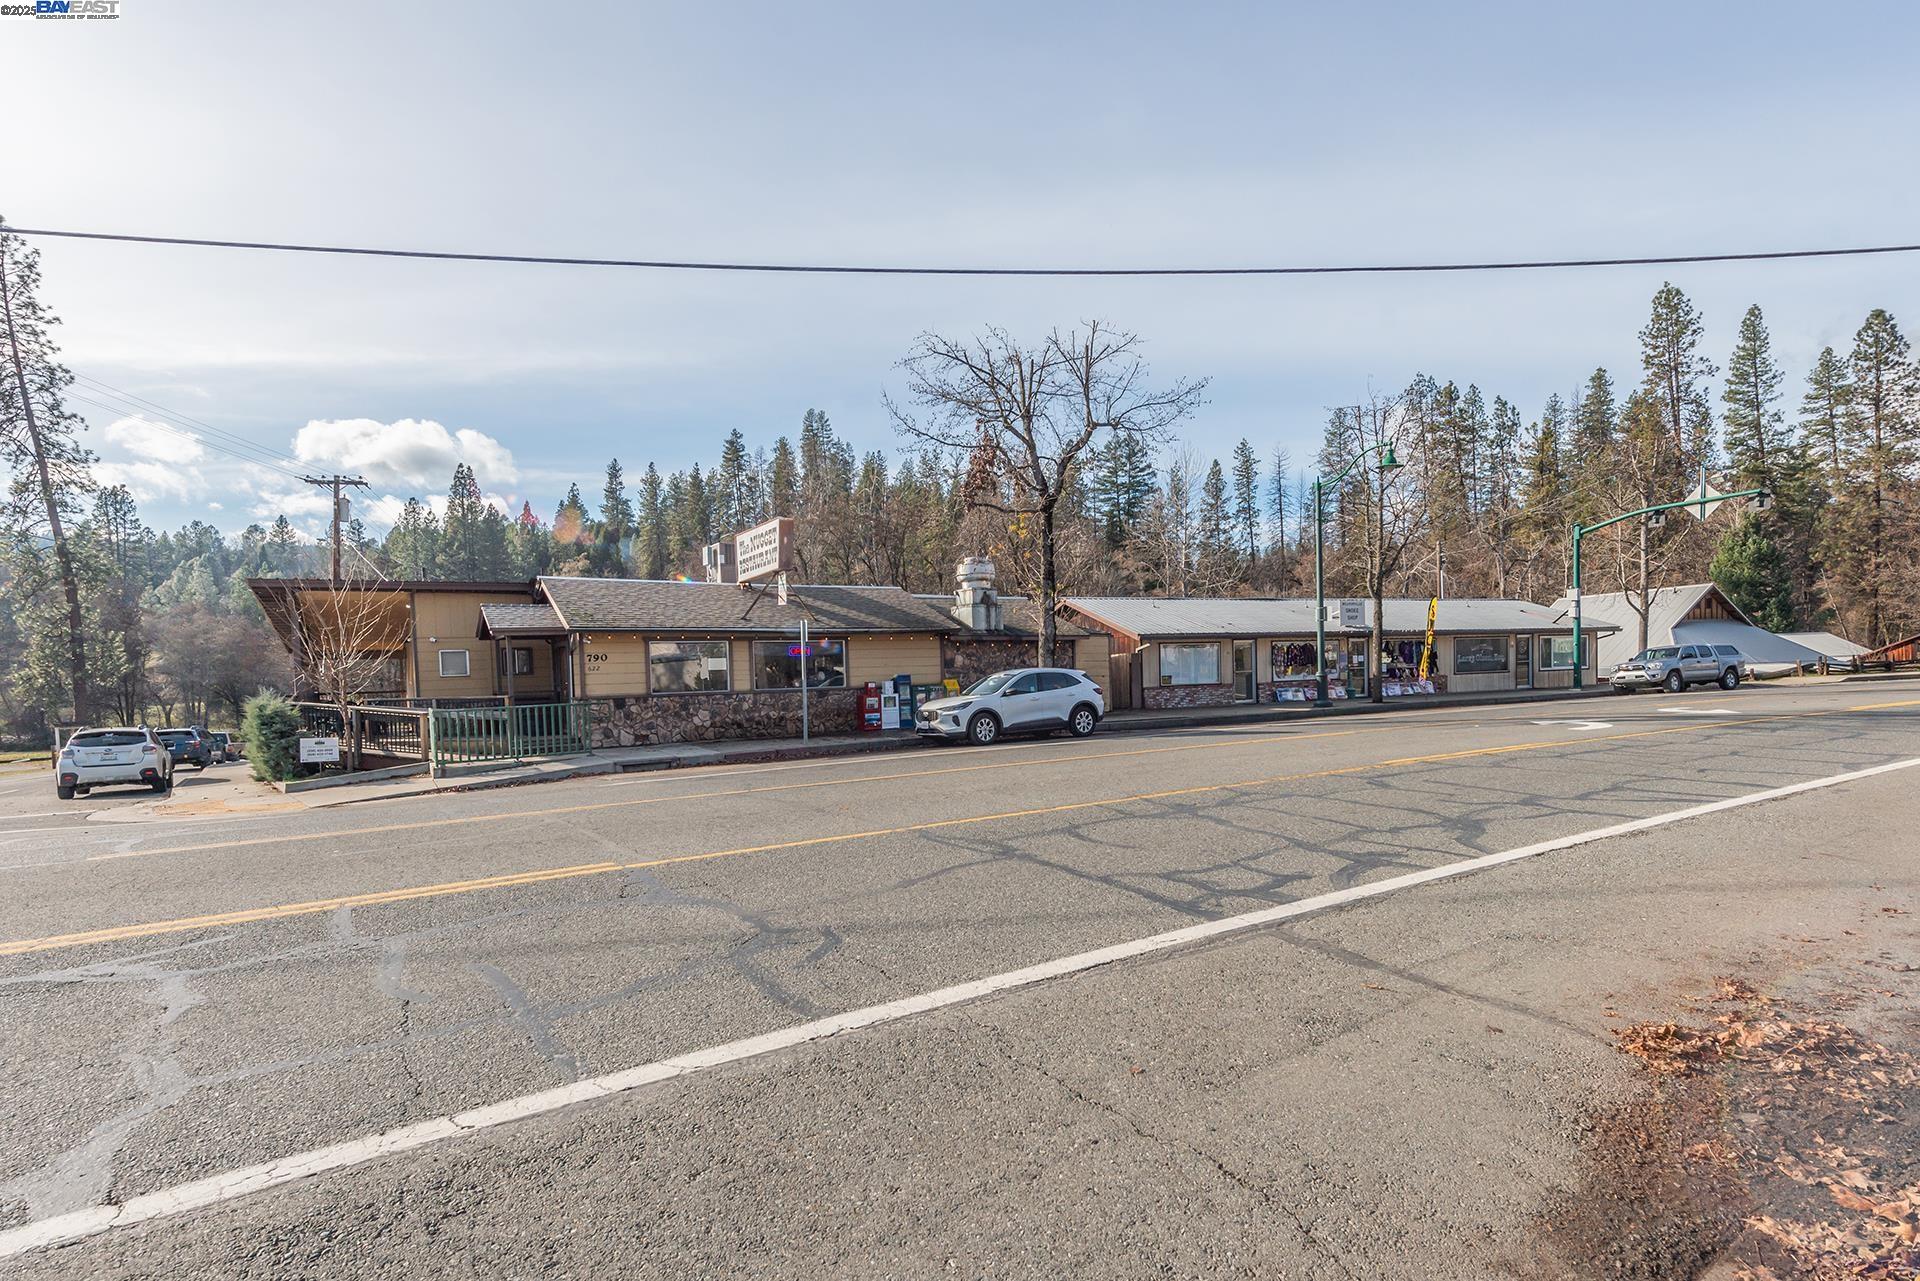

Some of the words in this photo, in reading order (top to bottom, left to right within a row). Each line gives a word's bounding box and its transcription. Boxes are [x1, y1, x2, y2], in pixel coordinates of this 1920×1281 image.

[750, 527, 777, 552] NUGGET
[739, 547, 777, 575] RESTAURANT
[587, 654, 608, 663] 790
[790, 647, 810, 656] OPN
